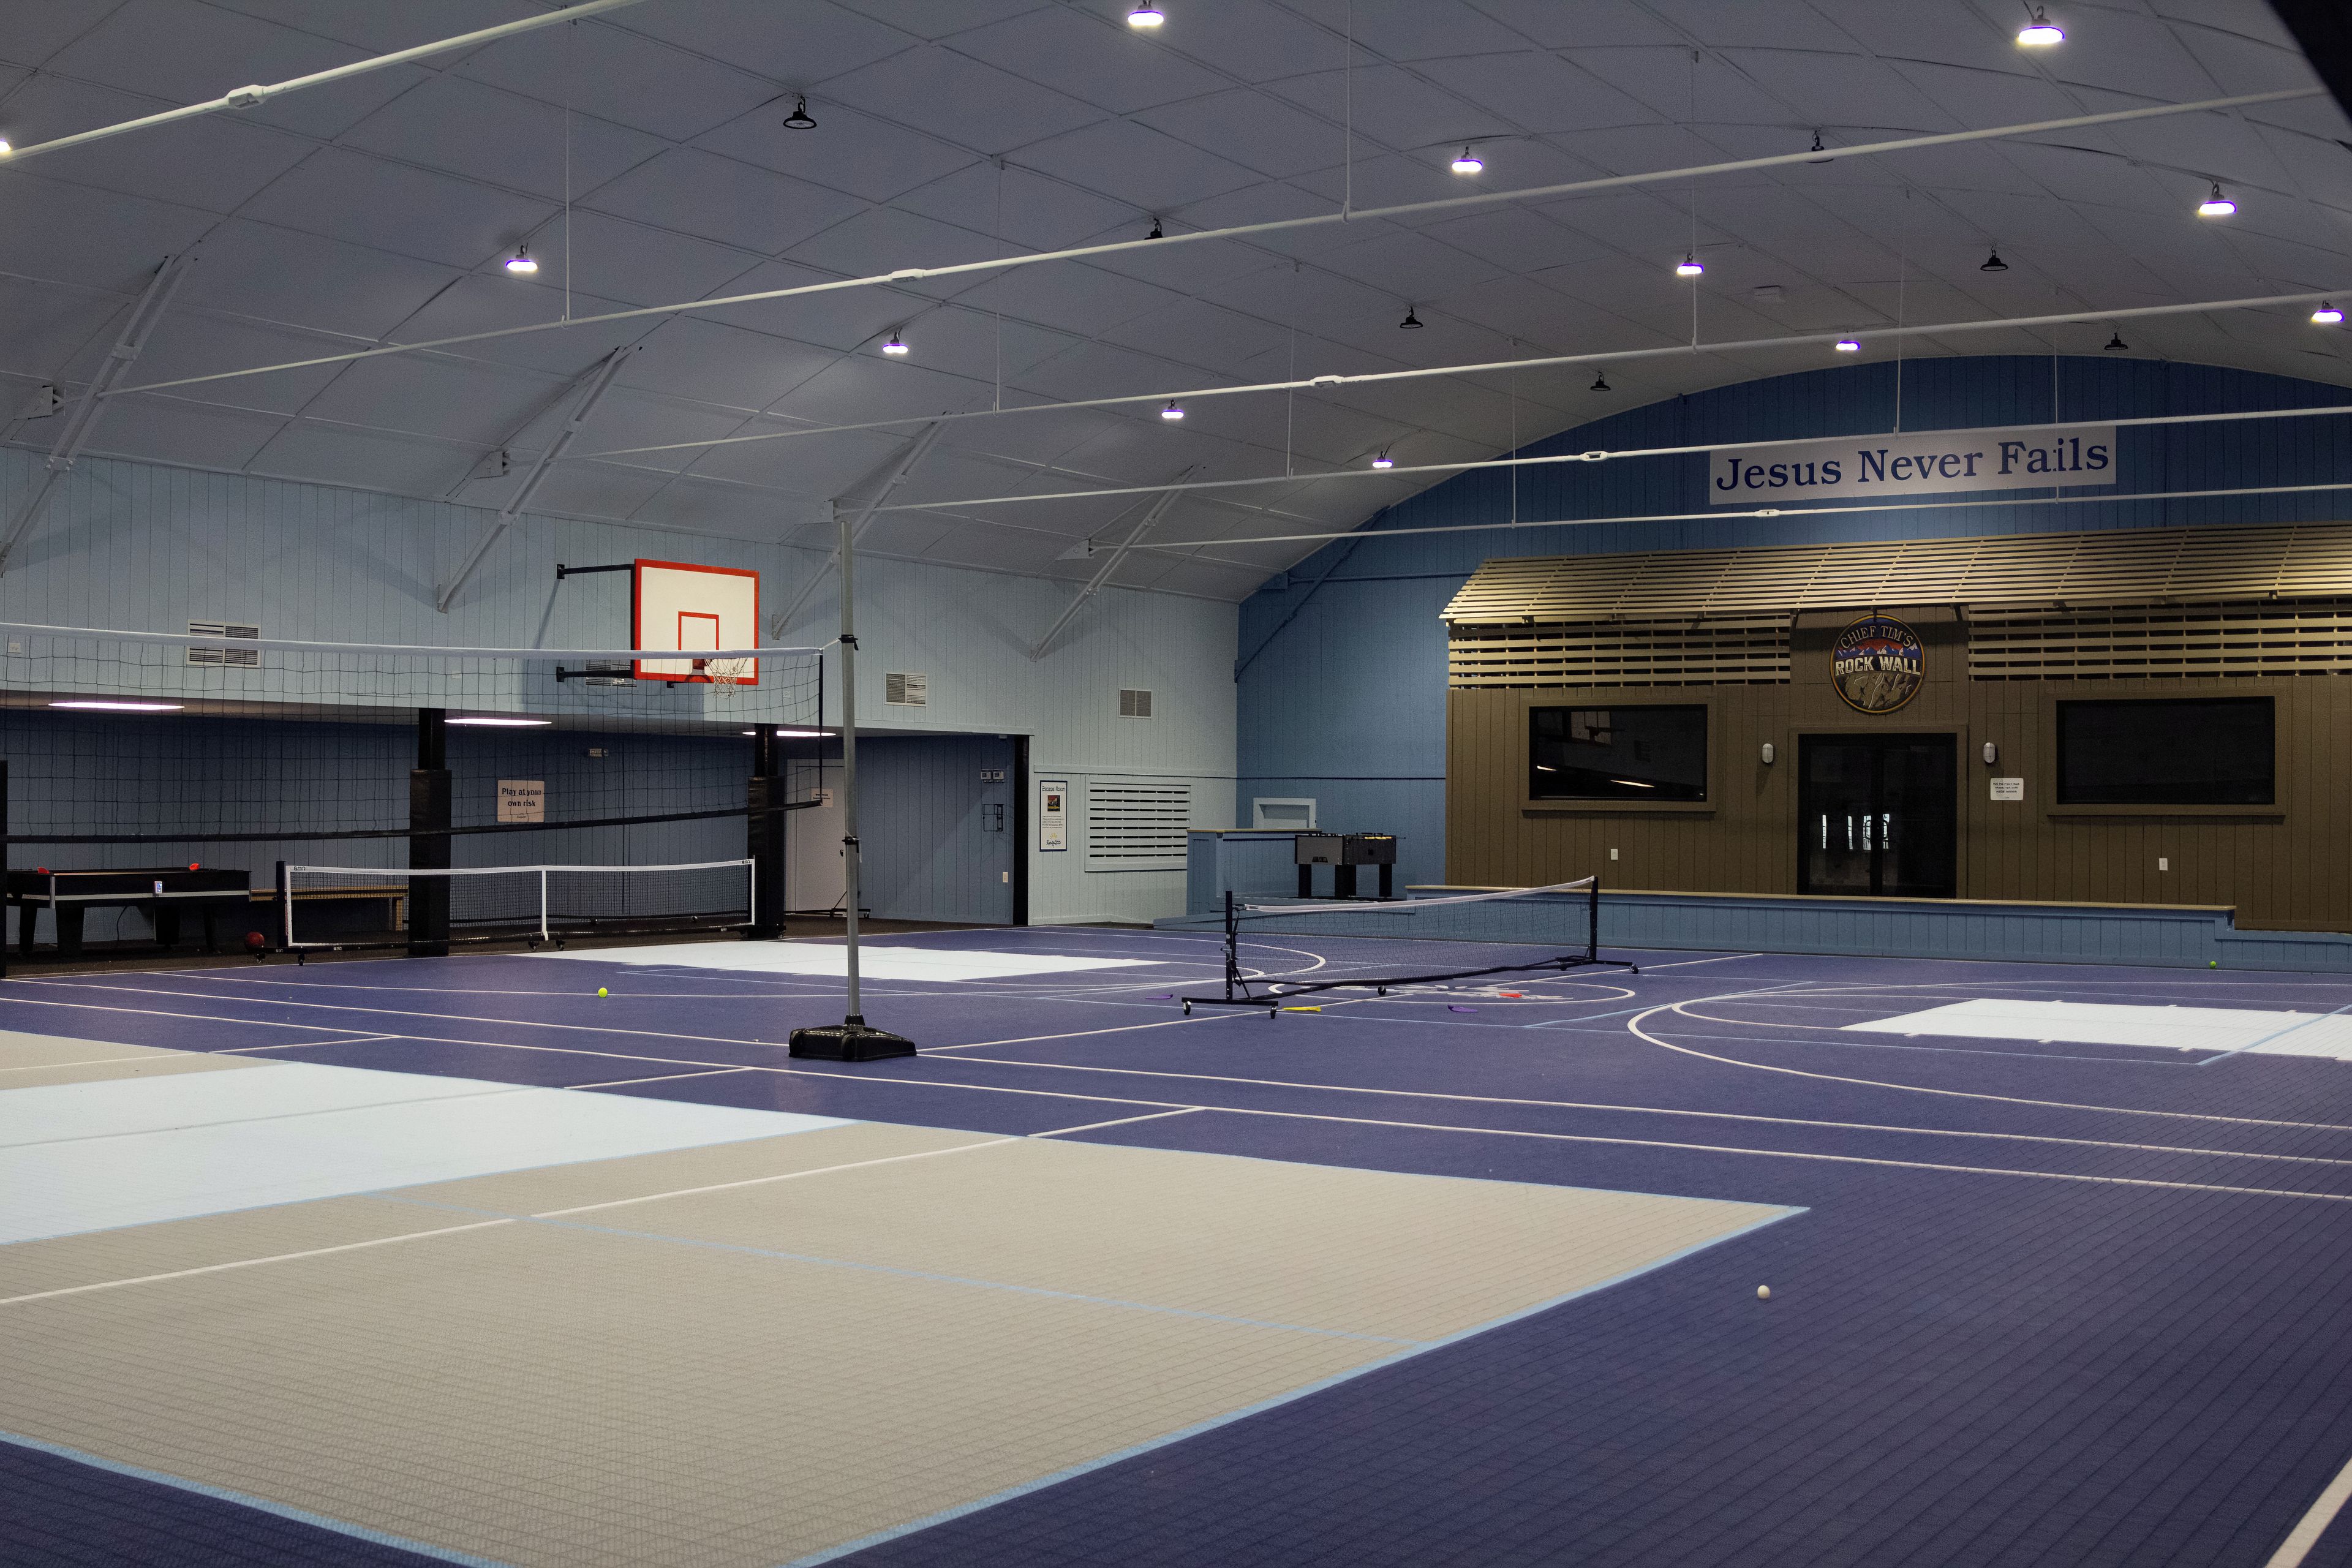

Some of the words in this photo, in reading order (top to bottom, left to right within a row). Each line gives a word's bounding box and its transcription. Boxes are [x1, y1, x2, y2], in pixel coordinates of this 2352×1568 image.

[1716, 459, 1842, 491] Jesus
[1857, 449, 1983, 483] Never
[1997, 437, 2109, 475] Fails
[1841, 625, 1875, 649] CHIEF
[1882, 625, 1913, 647] TIM'S
[1835, 656, 1874, 676] ROCK
[1879, 656, 1920, 675] WALL
[502, 788, 516, 796] Play
